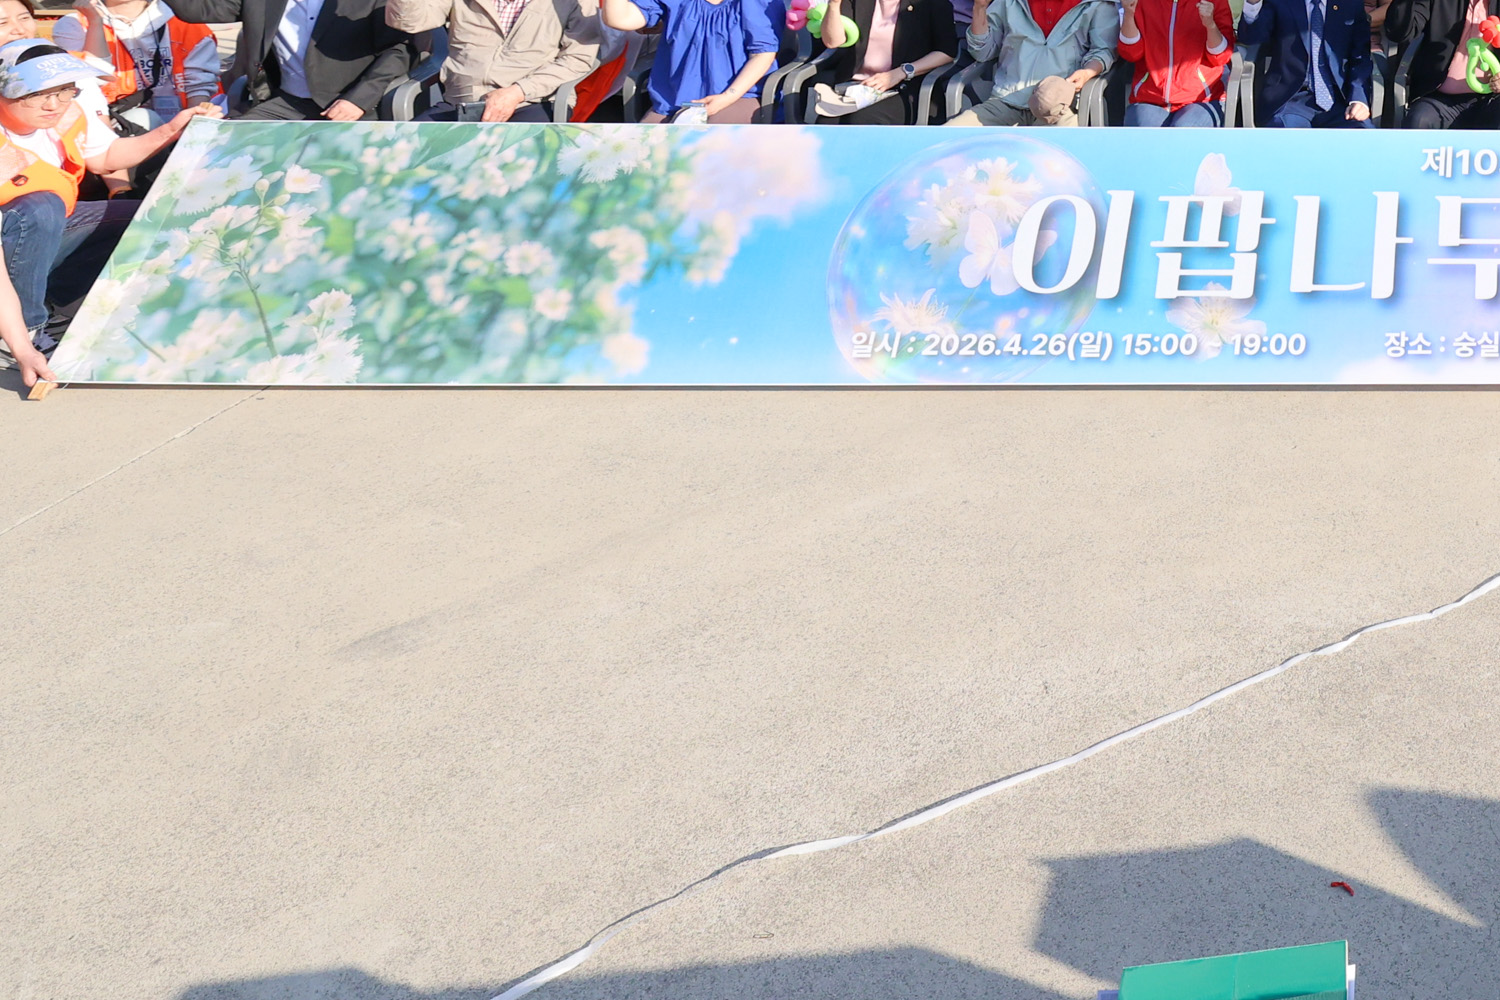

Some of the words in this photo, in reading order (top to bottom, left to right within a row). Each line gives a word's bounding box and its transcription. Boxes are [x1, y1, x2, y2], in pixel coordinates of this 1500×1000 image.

[851, 332, 900, 359] 일시
[921, 331, 1114, 361] 2026.4.26(일)
[1121, 332, 1199, 356] 15:00
[1230, 332, 1307, 356] 19:00
[1384, 331, 1433, 358] 장소
